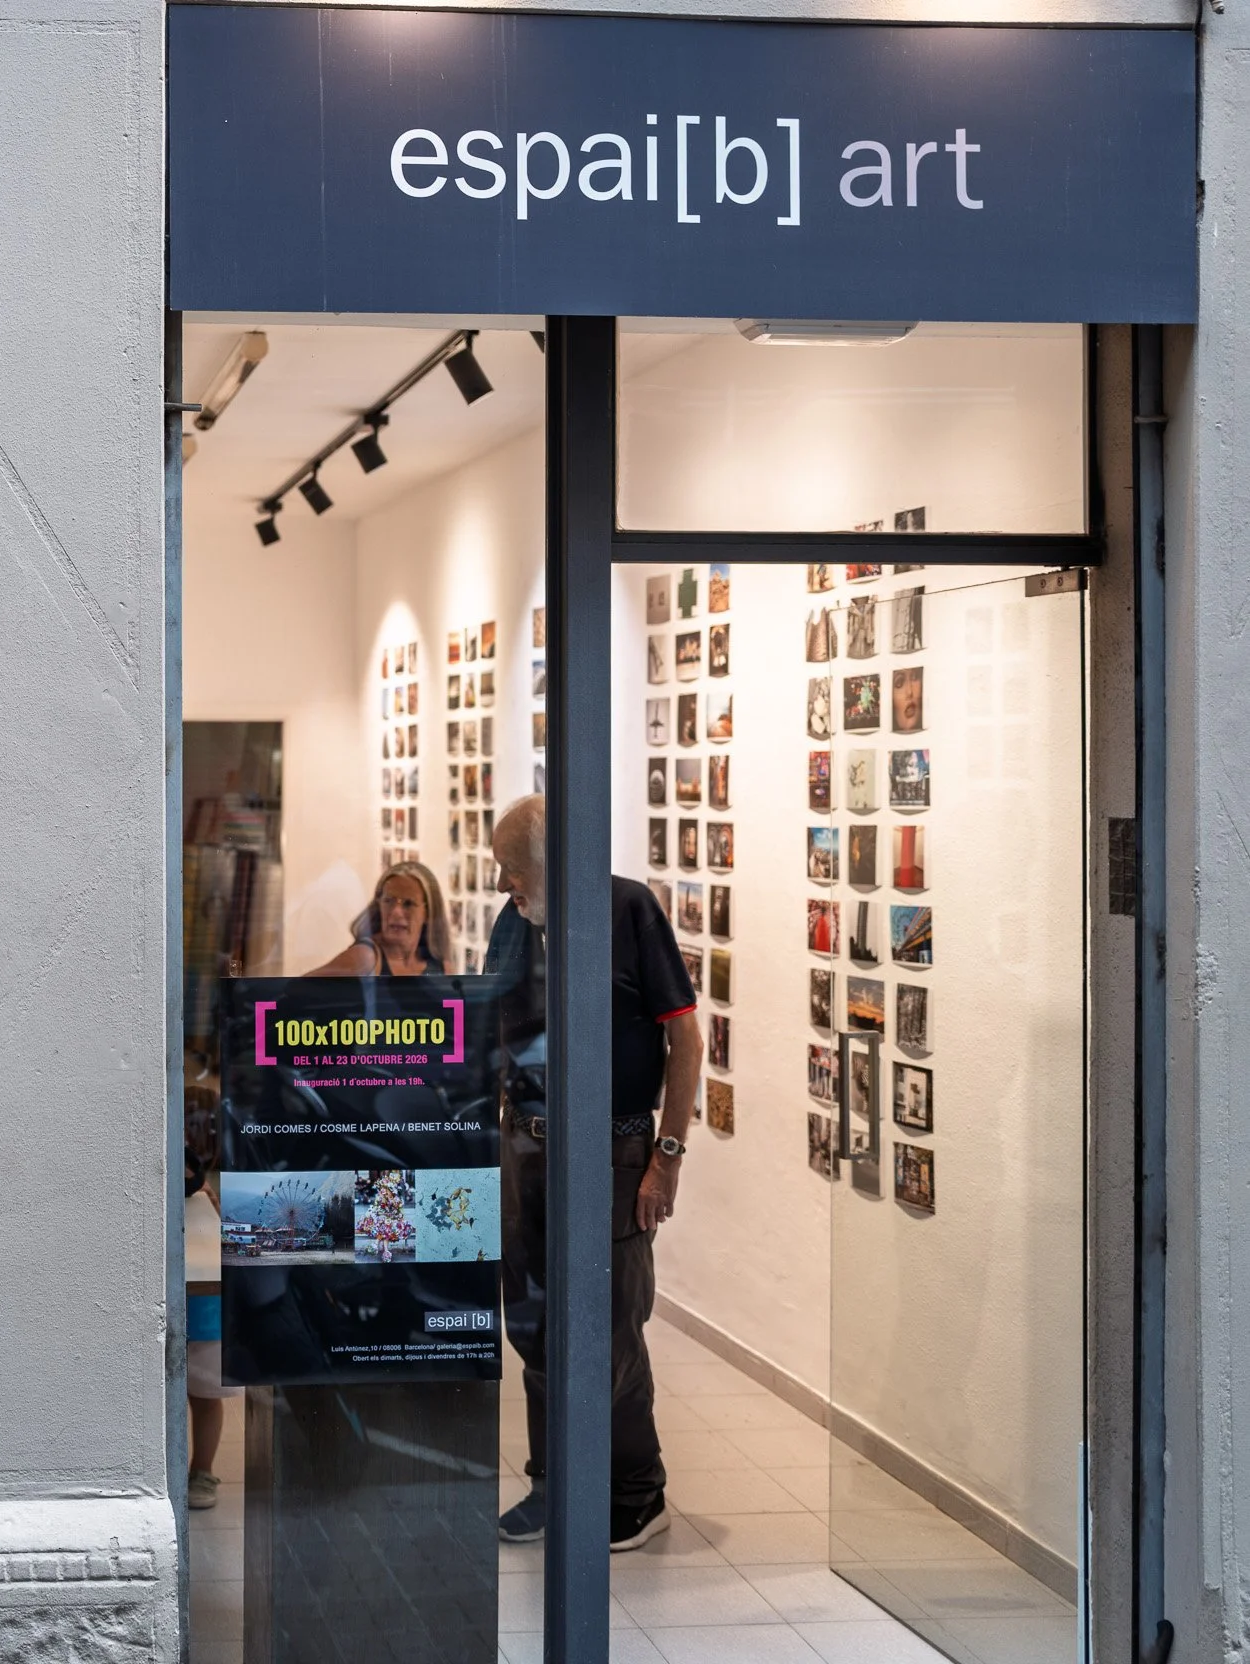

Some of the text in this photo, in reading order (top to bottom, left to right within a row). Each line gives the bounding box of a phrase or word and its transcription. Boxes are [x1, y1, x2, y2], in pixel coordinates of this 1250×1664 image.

[390, 114, 984, 226] espai[b] art
[275, 1018, 445, 1046] 100x100PHOTO
[293, 1054, 428, 1066] DEL 1 AL 23 D'OCTUBRE 2026
[293, 1078, 340, 1088] Inauguració
[395, 1078, 406, 1086] les
[408, 1077, 426, 1086] 19h.
[240, 1125, 272, 1134] JORDI
[274, 1124, 312, 1133] COMES
[320, 1123, 357, 1133] COSME
[359, 1123, 400, 1132] LAPENA
[408, 1122, 441, 1131] BENET
[444, 1121, 481, 1131] SOLINA
[427, 1312, 491, 1329] espai [b]
